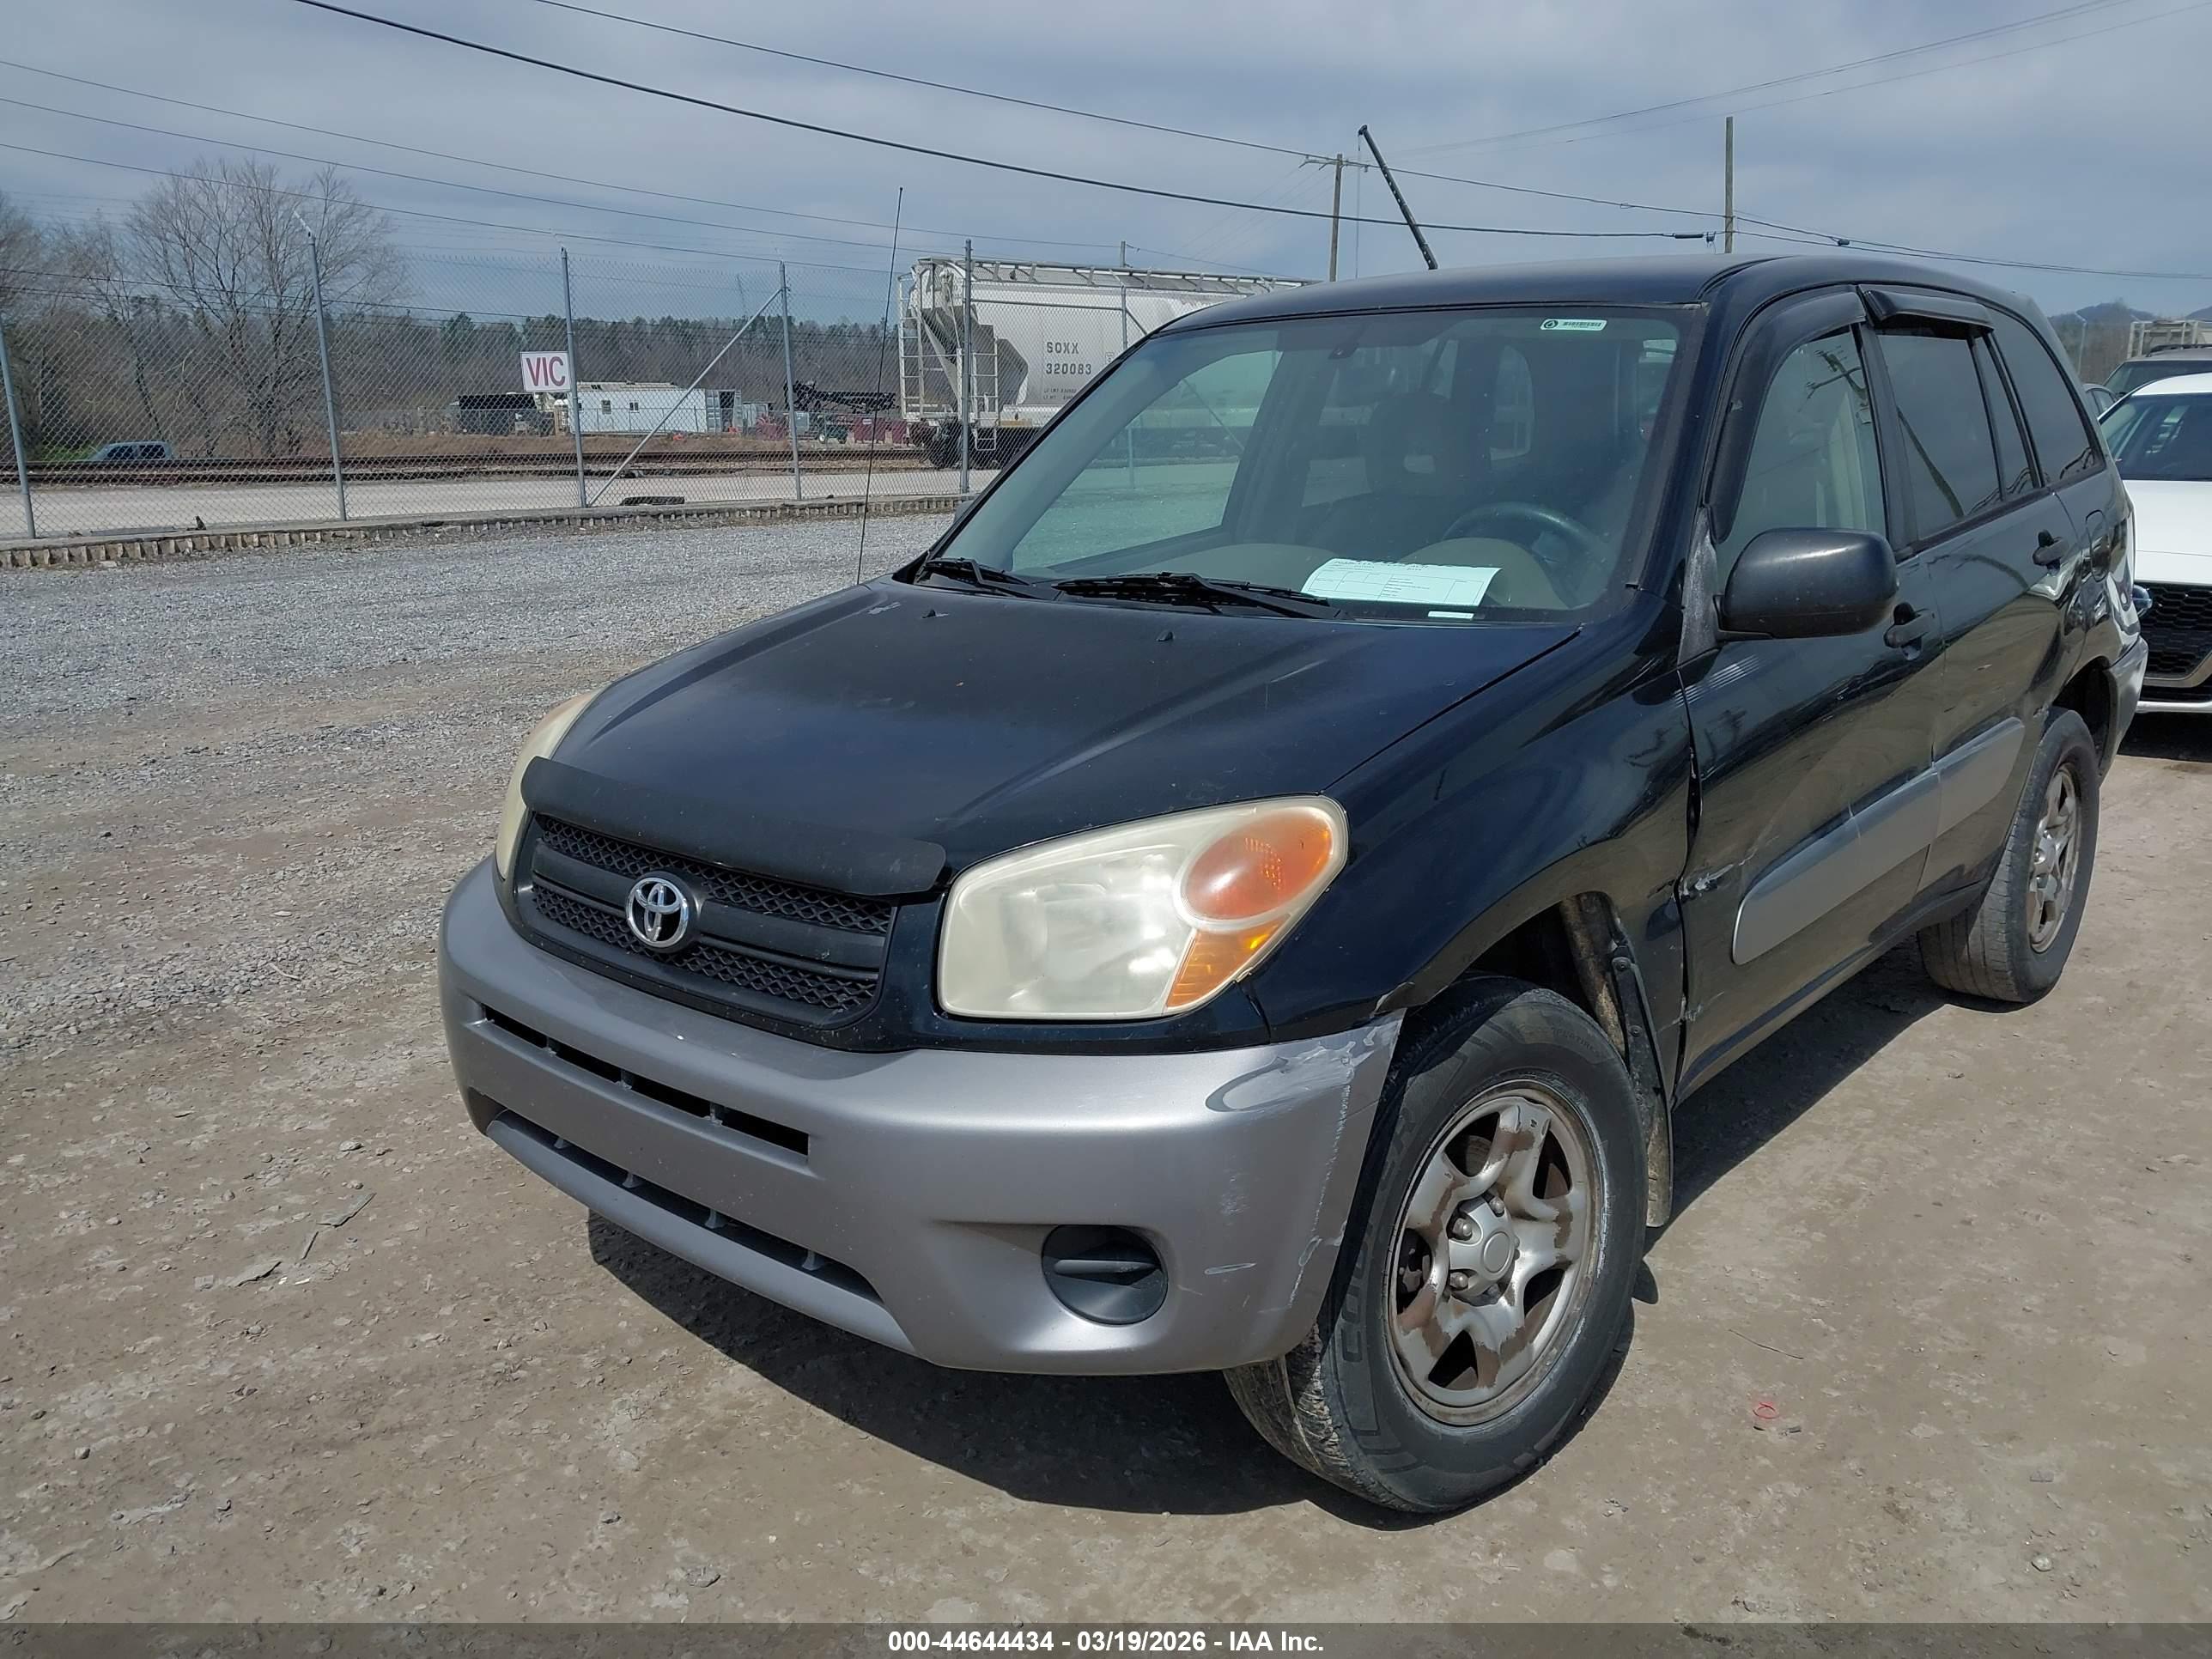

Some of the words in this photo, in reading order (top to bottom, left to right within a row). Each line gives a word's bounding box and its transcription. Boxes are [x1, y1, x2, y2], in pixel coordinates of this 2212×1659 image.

[1047, 342, 1079, 354] SOXX
[526, 356, 566, 386] VIC
[1046, 363, 1092, 375] 320083
